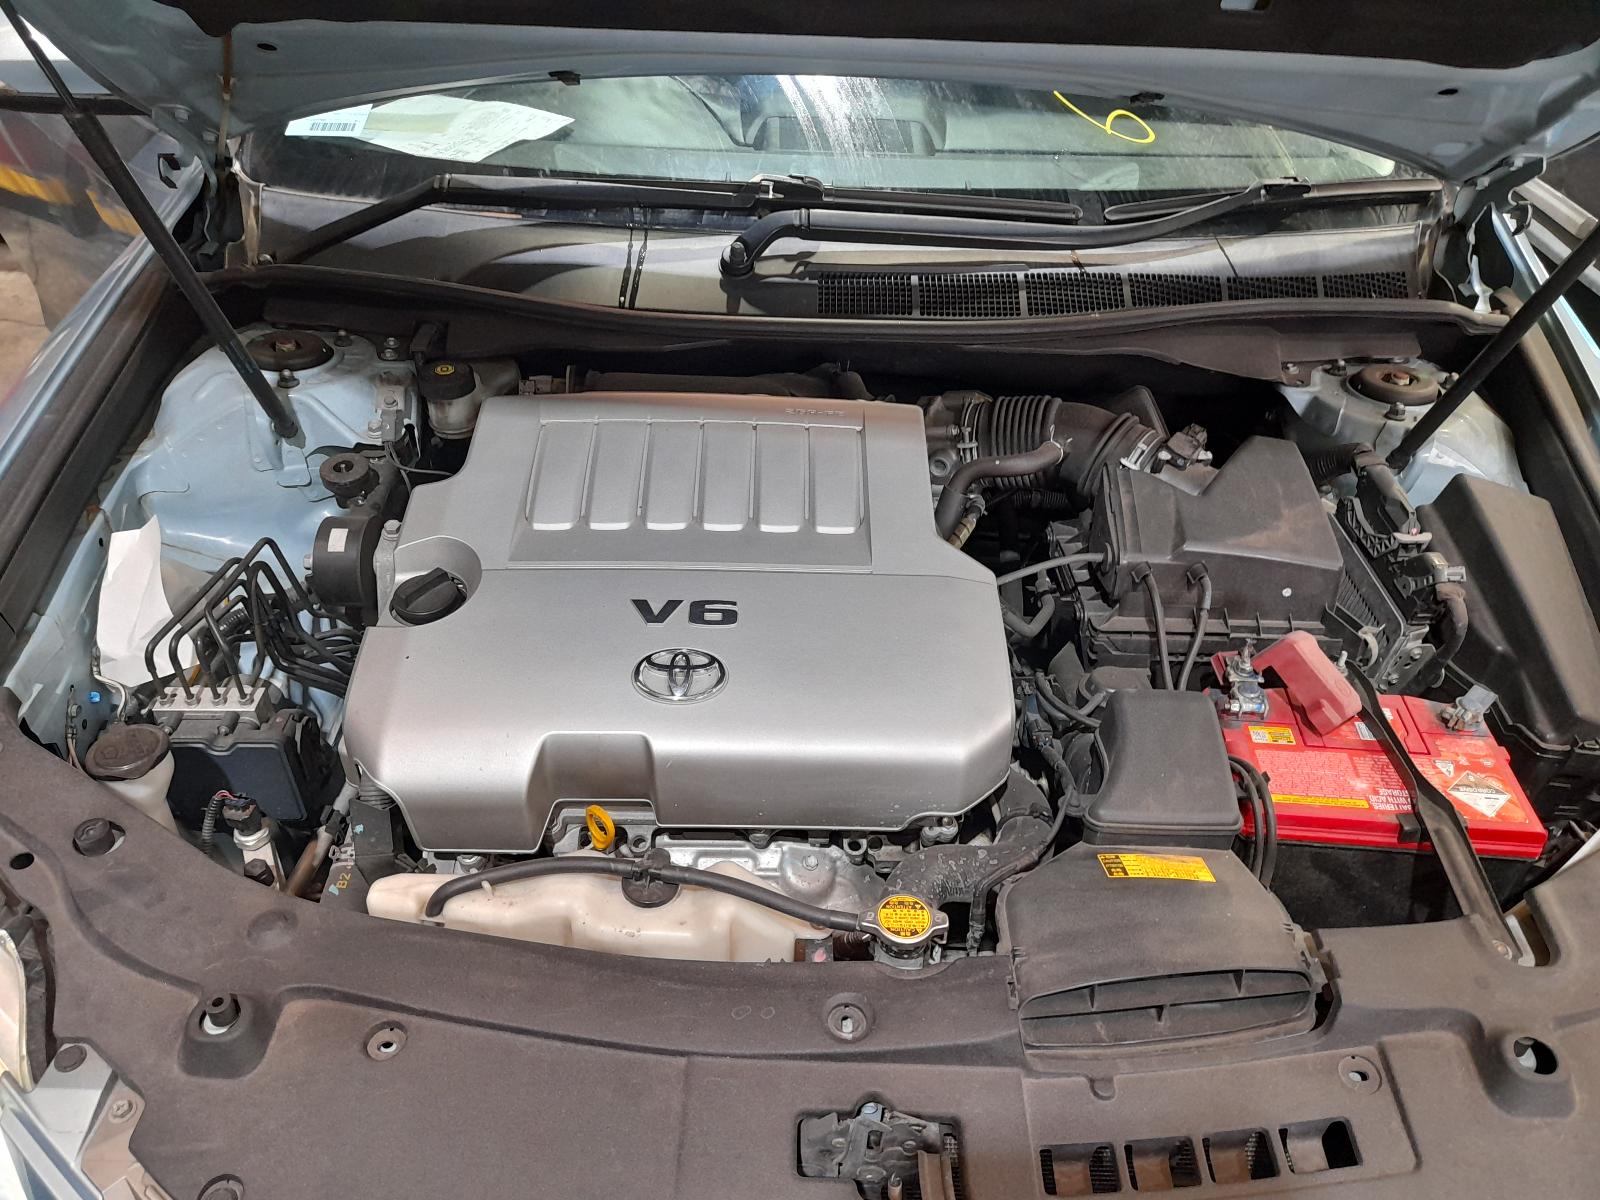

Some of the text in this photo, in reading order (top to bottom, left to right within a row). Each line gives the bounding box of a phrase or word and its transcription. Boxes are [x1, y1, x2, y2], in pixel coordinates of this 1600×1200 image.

[1053, 89, 1156, 144] 6
[629, 599, 738, 626] V6
[1386, 796, 1408, 804] WITH
